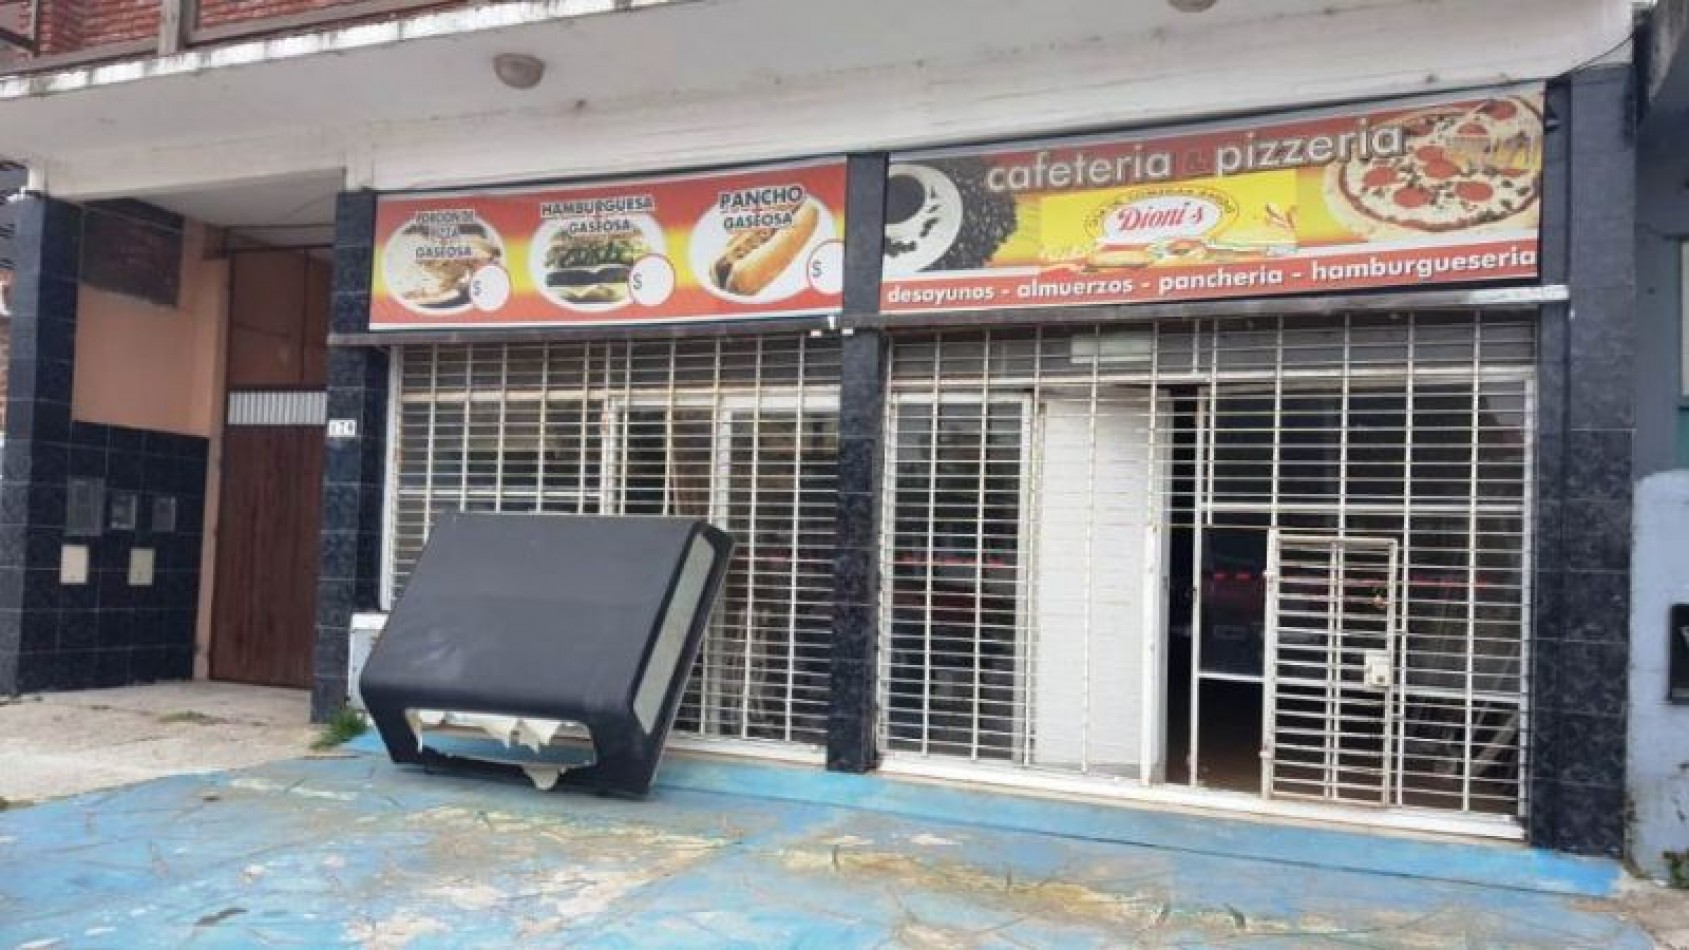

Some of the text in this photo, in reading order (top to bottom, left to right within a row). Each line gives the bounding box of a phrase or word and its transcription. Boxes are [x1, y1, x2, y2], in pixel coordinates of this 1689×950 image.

[986, 144, 1173, 191] cafeteria
[1215, 117, 1402, 177] pizzeria
[542, 197, 653, 216] HAMBURGUESA
[720, 186, 803, 209] PANCHO
[570, 219, 630, 232] GASEOSA
[724, 212, 792, 229] GASEOSA
[887, 285, 995, 304] desayunos
[1017, 277, 1132, 298] almuerzos
[1159, 266, 1283, 294] pancheria
[1312, 247, 1536, 280] hamburgueseria
